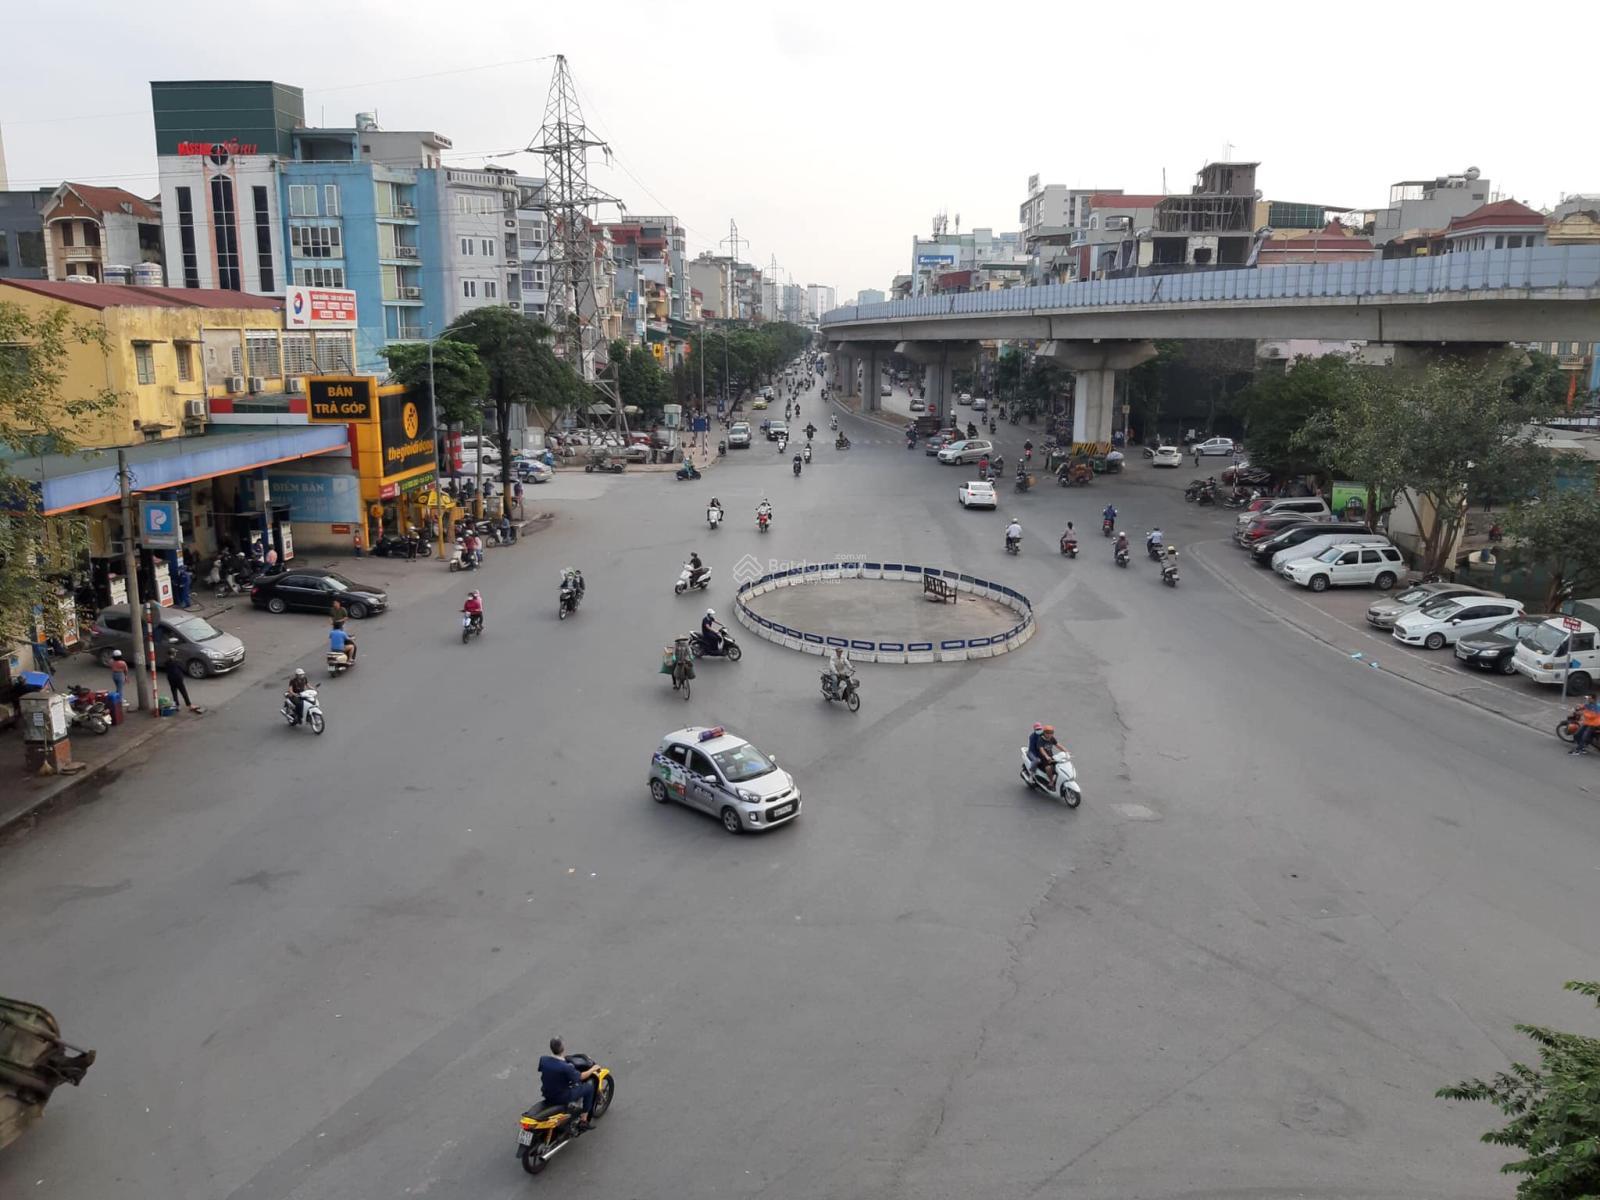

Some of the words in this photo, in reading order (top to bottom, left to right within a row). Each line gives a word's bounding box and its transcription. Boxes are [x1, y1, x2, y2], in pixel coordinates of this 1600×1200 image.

[327, 385, 353, 397] BÁN
[314, 400, 338, 414] TRẢ
[340, 401, 367, 414] GÓP
